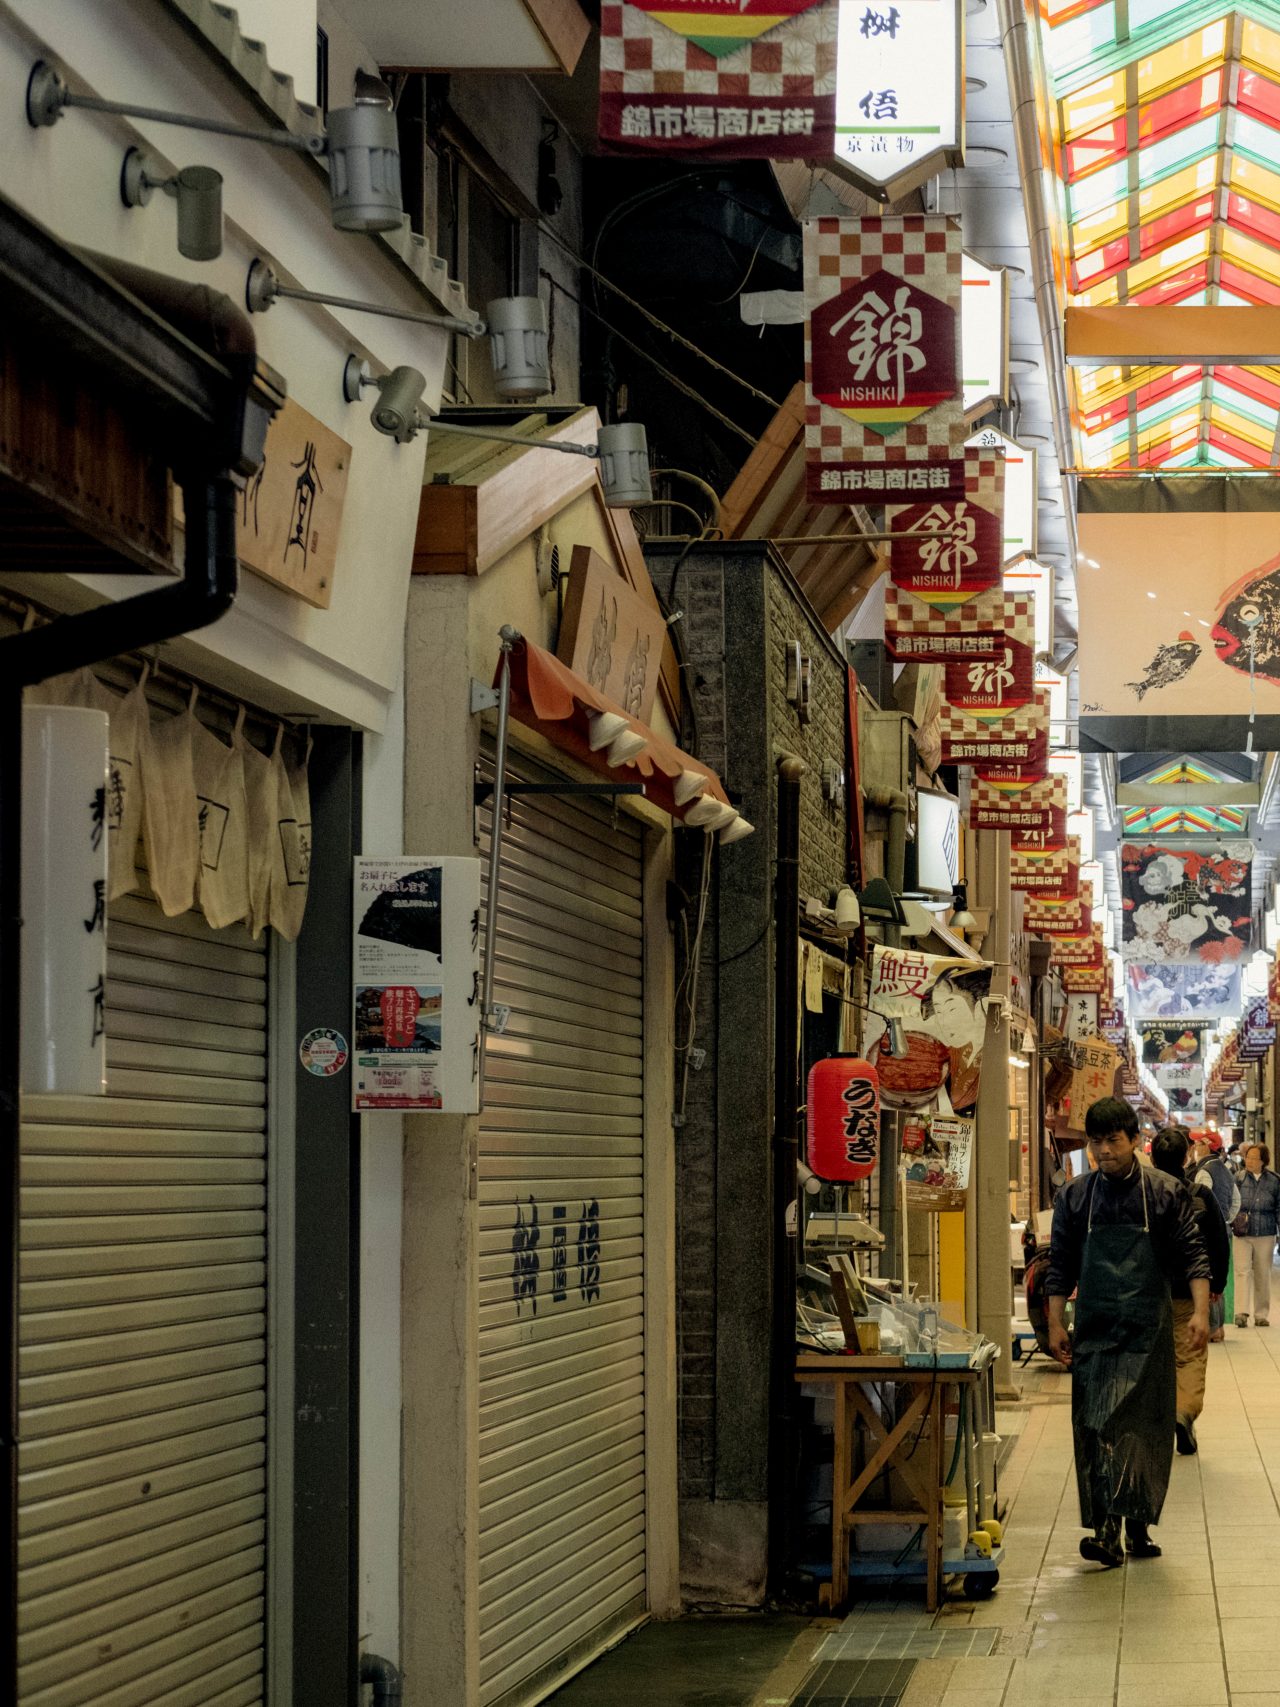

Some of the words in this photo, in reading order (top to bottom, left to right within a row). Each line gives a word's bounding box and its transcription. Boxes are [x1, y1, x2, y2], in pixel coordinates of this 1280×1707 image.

[622, 105, 815, 138] 錦市場商店街
[847, 136, 914, 153] 京漬物
[829, 286, 926, 405] 錦
[841, 387, 895, 401] NISHIKI
[820, 468, 949, 490] 錦市場商店街
[905, 502, 978, 590] 錦
[912, 575, 954, 587] NISHIKI
[896, 637, 994, 653] 錦市場商店街
[963, 695, 996, 704] NISHIKI
[950, 744, 1028, 758] 錦市場商店街
[988, 771, 1016, 780] NISHIKI
[978, 811, 1042, 825] 錦市場商店街
[874, 950, 929, 1000] 鰻
[843, 1079, 877, 1164] うなぎ
